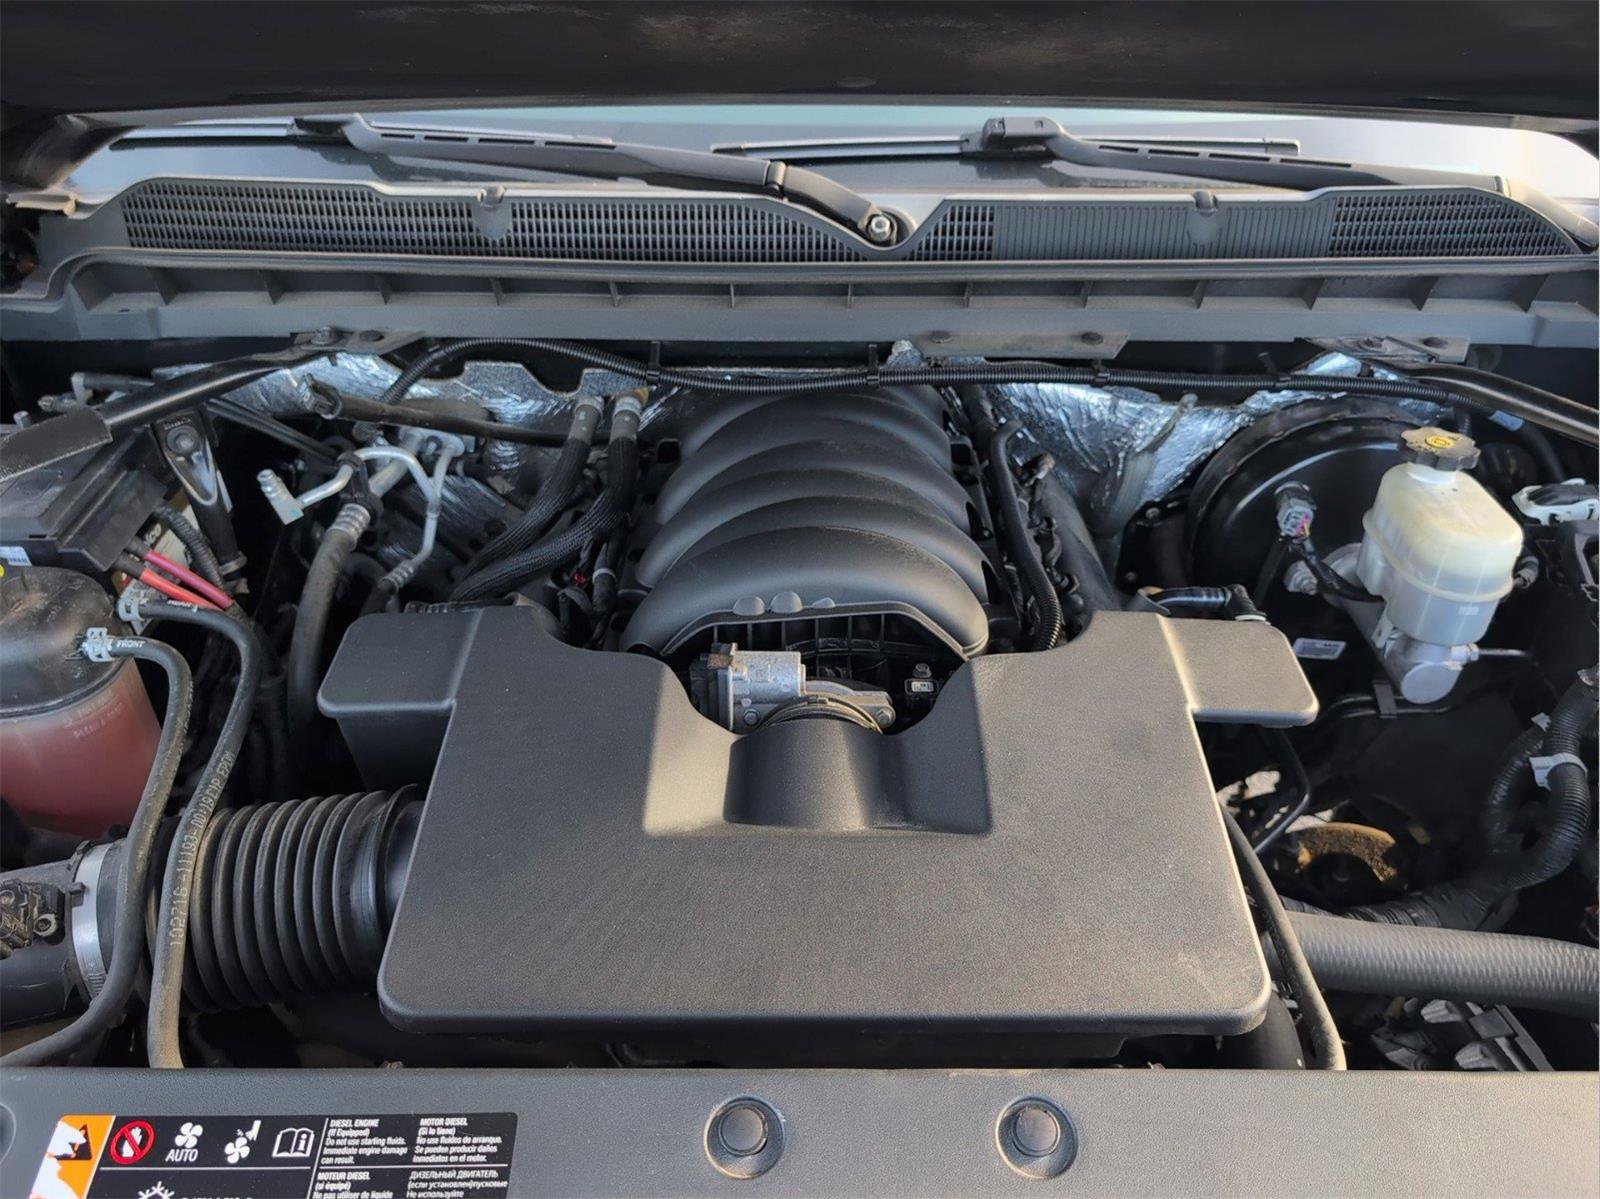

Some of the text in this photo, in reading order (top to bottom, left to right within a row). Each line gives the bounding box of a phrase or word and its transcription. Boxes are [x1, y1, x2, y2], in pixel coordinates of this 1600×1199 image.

[116, 640, 146, 648] FRONT
[330, 1119, 380, 1128] DIESEL ENGINE
[420, 1117, 468, 1126] MOTOR DIESEL
[337, 1128, 370, 1137] Equipped)
[325, 1137, 406, 1147] Do not use starting fluids.
[416, 1136, 426, 1144] No
[440, 1136, 462, 1144] fluidos
[358, 1147, 381, 1156] engine
[381, 1147, 408, 1156] damage
[415, 1145, 424, 1153] Se
[424, 1146, 449, 1154] pueden
[449, 1145, 477, 1154] producir
[165, 1149, 199, 1162] AUTO
[317, 1171, 371, 1180] MOTEUR DIESEL
[409, 1169, 499, 1180] ДИЗЕЛЬНЫЙ ДВИГАТЕЛЬ
[312, 1191, 322, 1199] Ne
[360, 1191, 370, 1199] de
